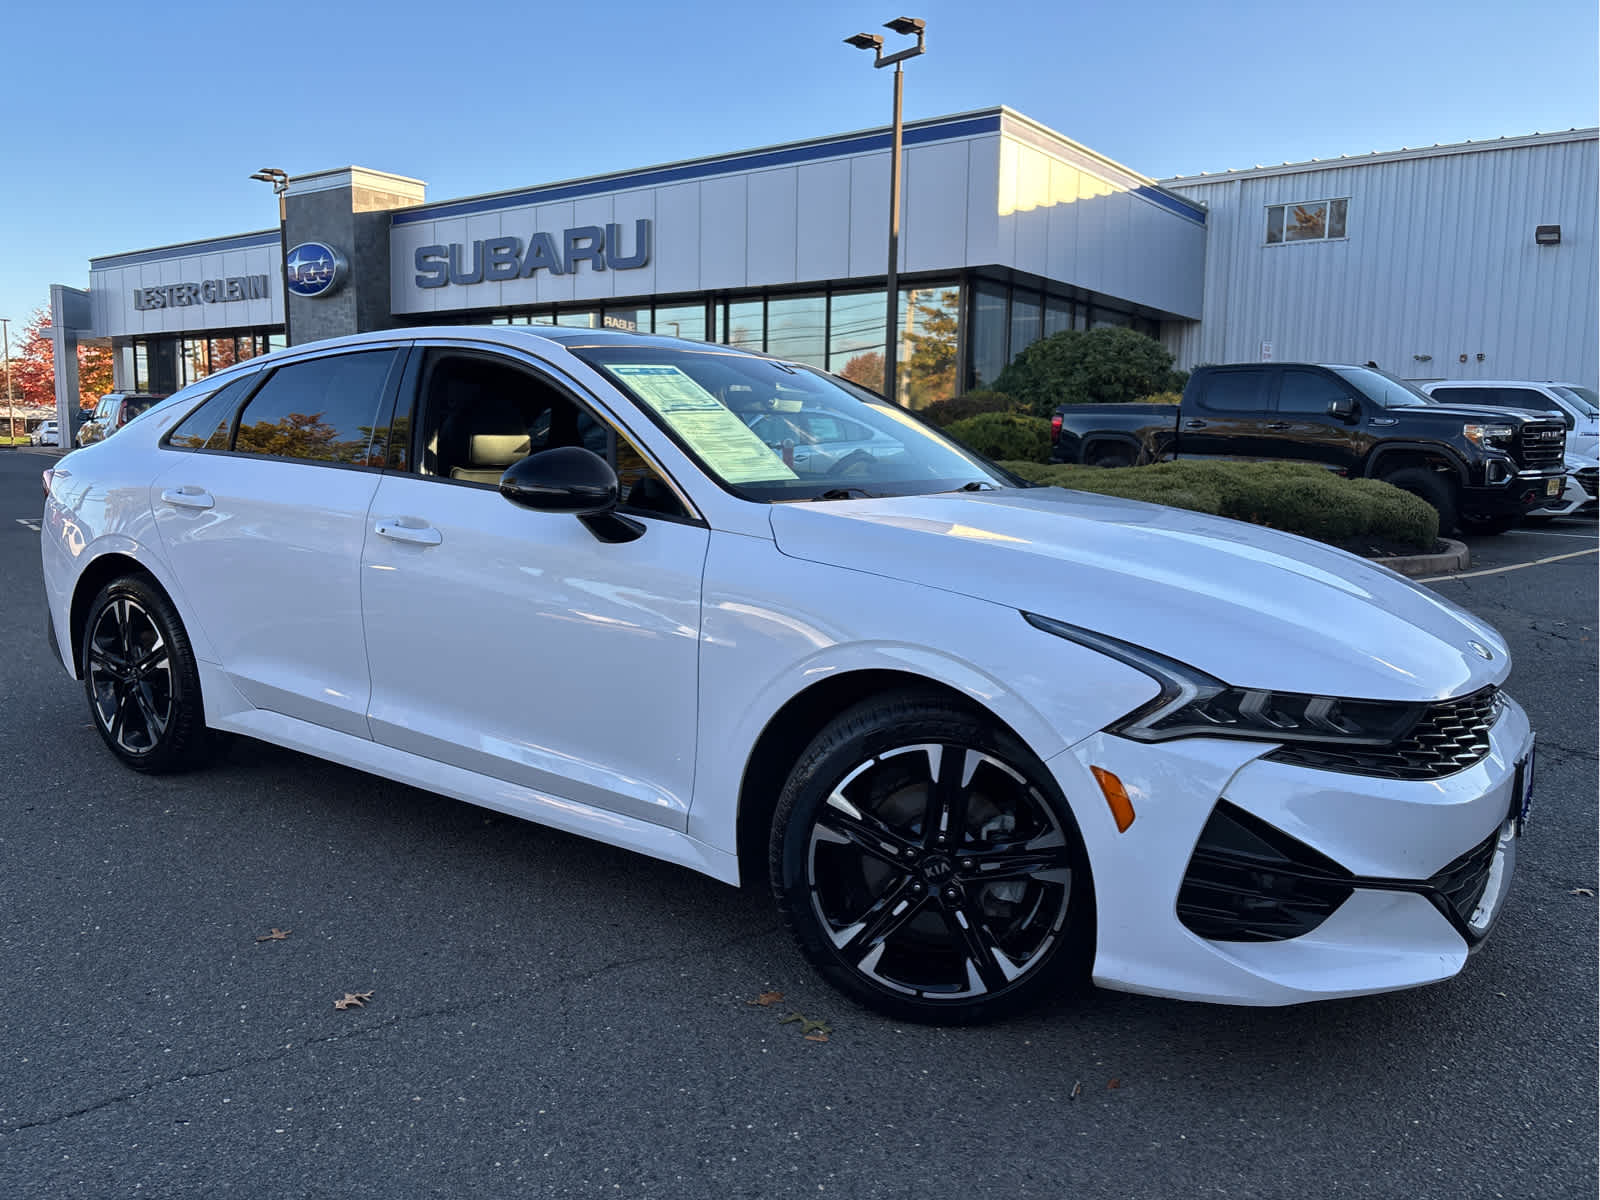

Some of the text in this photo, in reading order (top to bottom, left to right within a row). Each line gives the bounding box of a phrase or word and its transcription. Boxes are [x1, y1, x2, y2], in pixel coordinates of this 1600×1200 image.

[415, 219, 650, 288] SUBARU
[134, 275, 268, 310] LESTER GLENN
[924, 862, 951, 878] KIA
